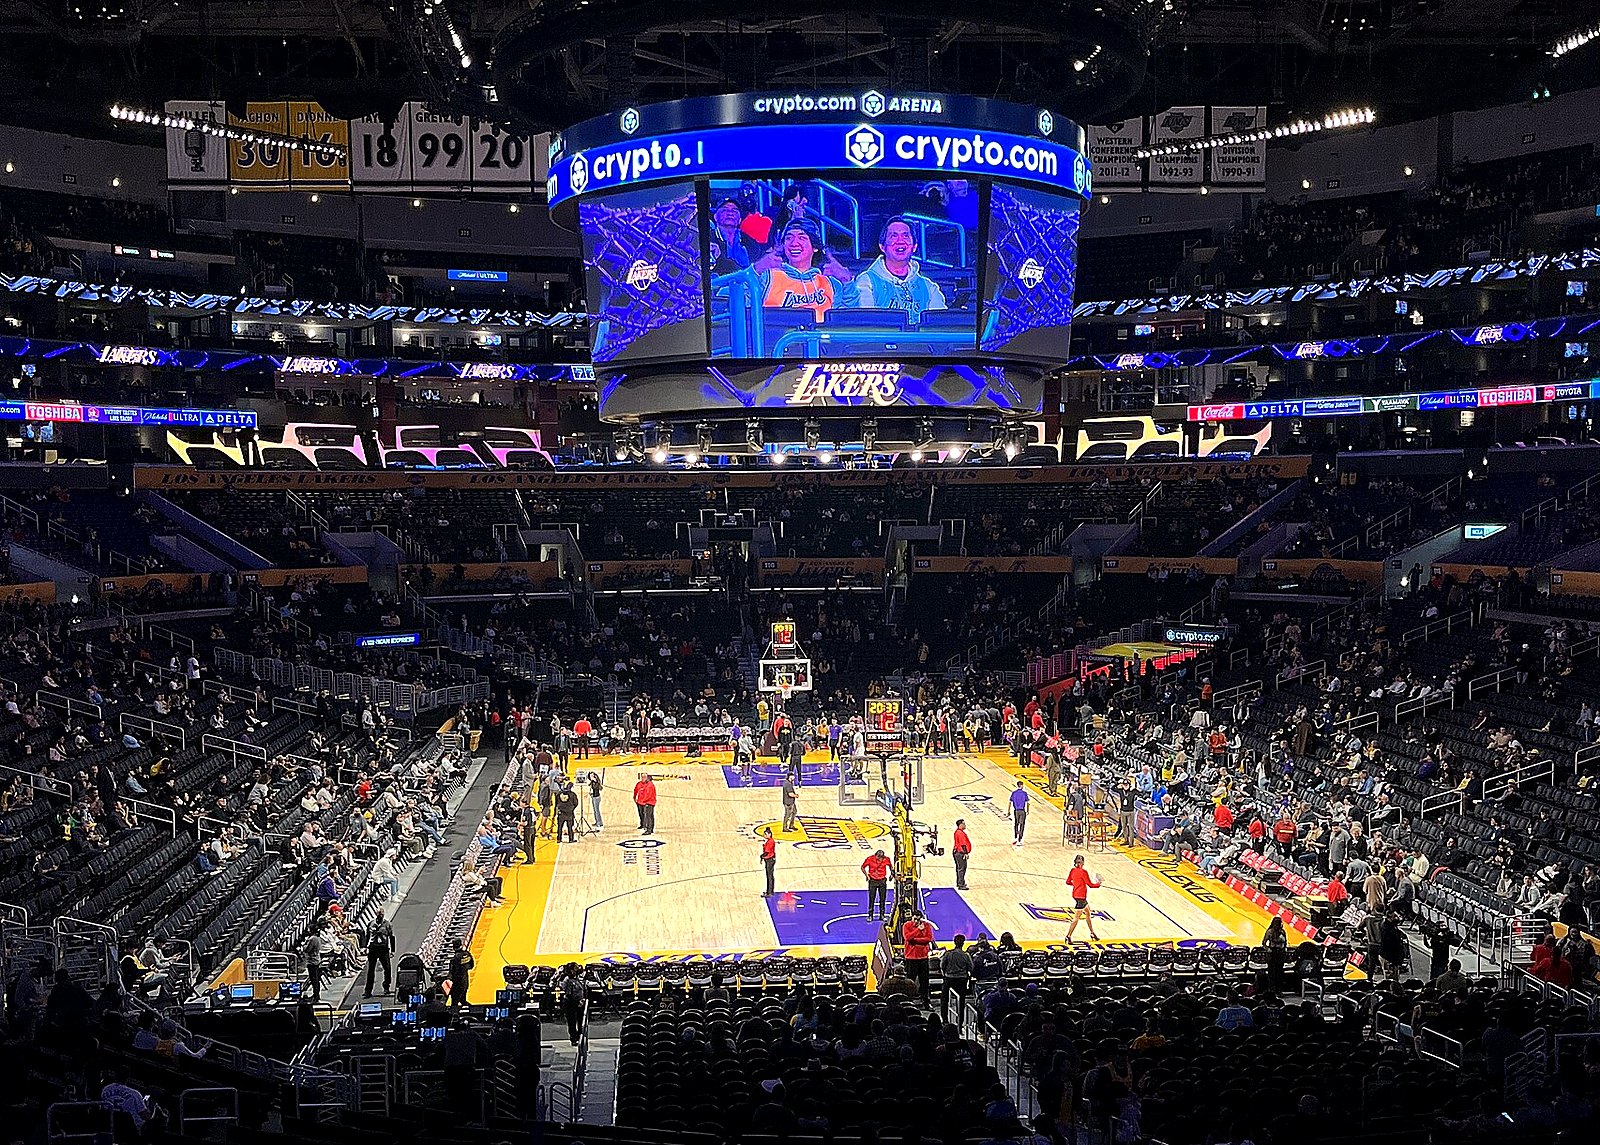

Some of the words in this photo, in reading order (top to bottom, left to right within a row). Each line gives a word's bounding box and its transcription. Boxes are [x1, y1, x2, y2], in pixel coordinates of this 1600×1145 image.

[754, 94, 856, 114] crypto.com
[888, 96, 942, 113] ARENA
[237, 138, 281, 168] 30
[302, 132, 338, 168] 16
[363, 134, 398, 168] 18
[418, 132, 464, 168] 99
[479, 134, 523, 168] 20
[895, 134, 1058, 177] crypto.com
[1222, 147, 1256, 155] DIVISION
[1155, 156, 1198, 164] CHAMPIONS
[1217, 156, 1260, 164] CHAMPIONS
[1098, 168, 1130, 177] 2011-12
[1159, 168, 1194, 177] 1992-93
[1222, 168, 1256, 177] 1990-91
[823, 363, 845, 372] LOS
[846, 363, 900, 372] ANGELES
[786, 364, 904, 406] LAKERS
[1481, 388, 1533, 403] TOSHIBA
[1556, 387, 1583, 396] TOYOTA
[1450, 395, 1477, 404] ULTRA
[28, 405, 81, 419] TOSHIBA
[1261, 405, 1300, 415] DELTA
[172, 412, 199, 422] ULTRA
[216, 414, 254, 424] DELTA
[161, 473, 200, 484] LOS
[207, 473, 293, 484] ANGELES
[297, 474, 377, 484] LAKERS
[469, 474, 506, 484] LOS
[869, 702, 899, 714] 20:33
[880, 712, 897, 731] 12
[1159, 869, 1224, 903] LEXUS
